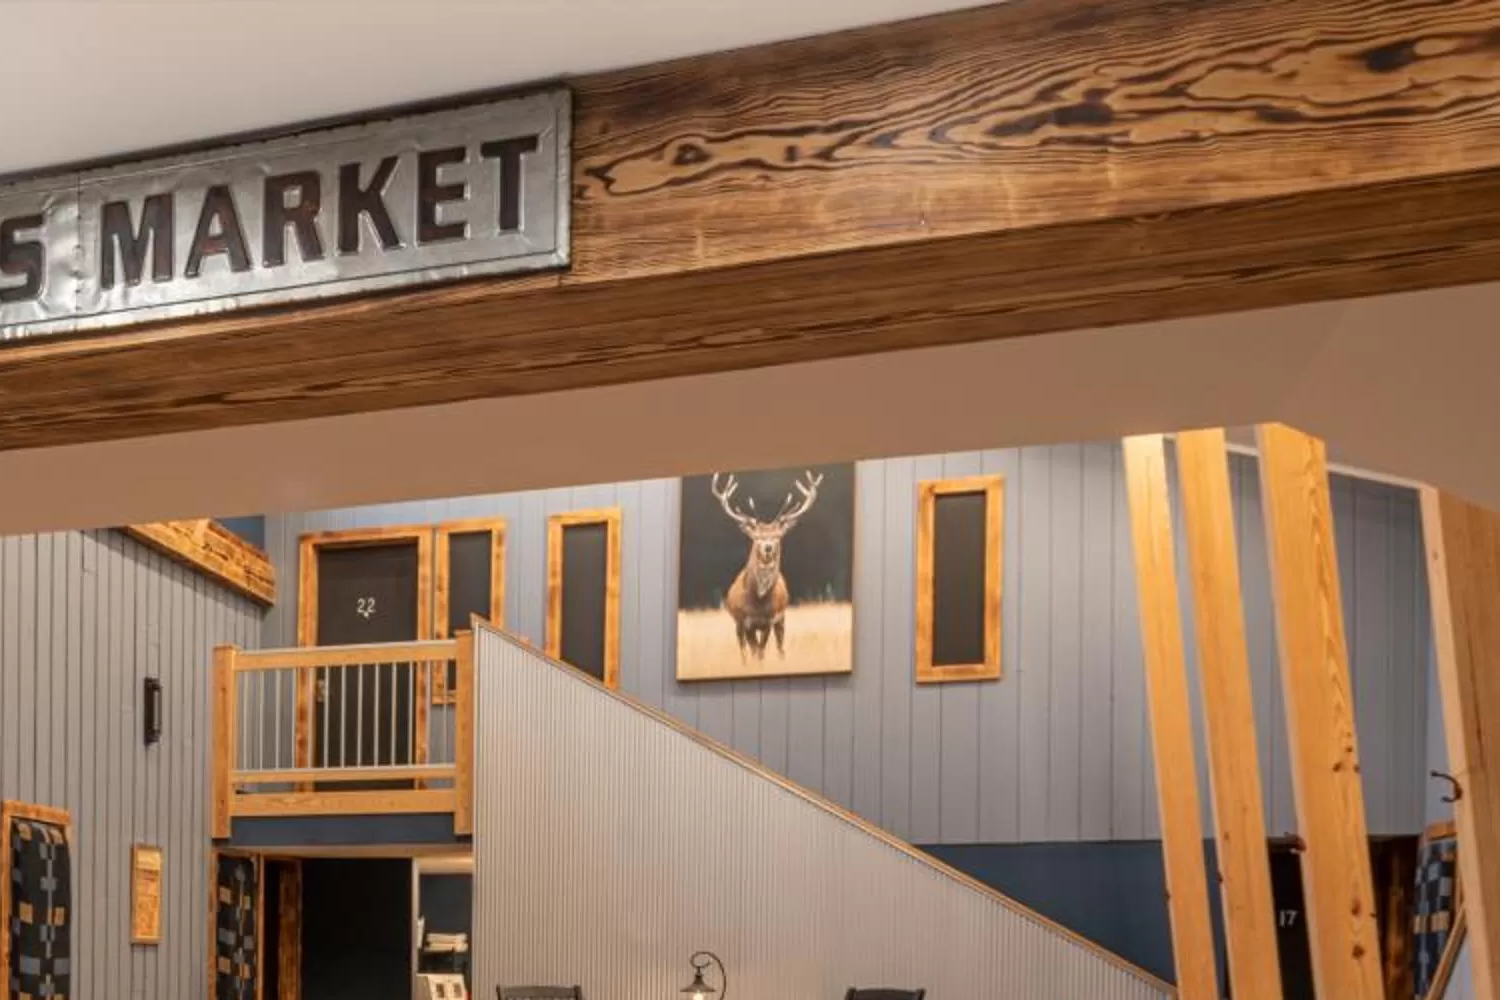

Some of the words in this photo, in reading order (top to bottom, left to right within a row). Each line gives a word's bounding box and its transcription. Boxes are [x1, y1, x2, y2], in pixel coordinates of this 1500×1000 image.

[99, 133, 540, 290] MARKET
[356, 597, 376, 613] 22
[1279, 909, 1299, 927] 17
